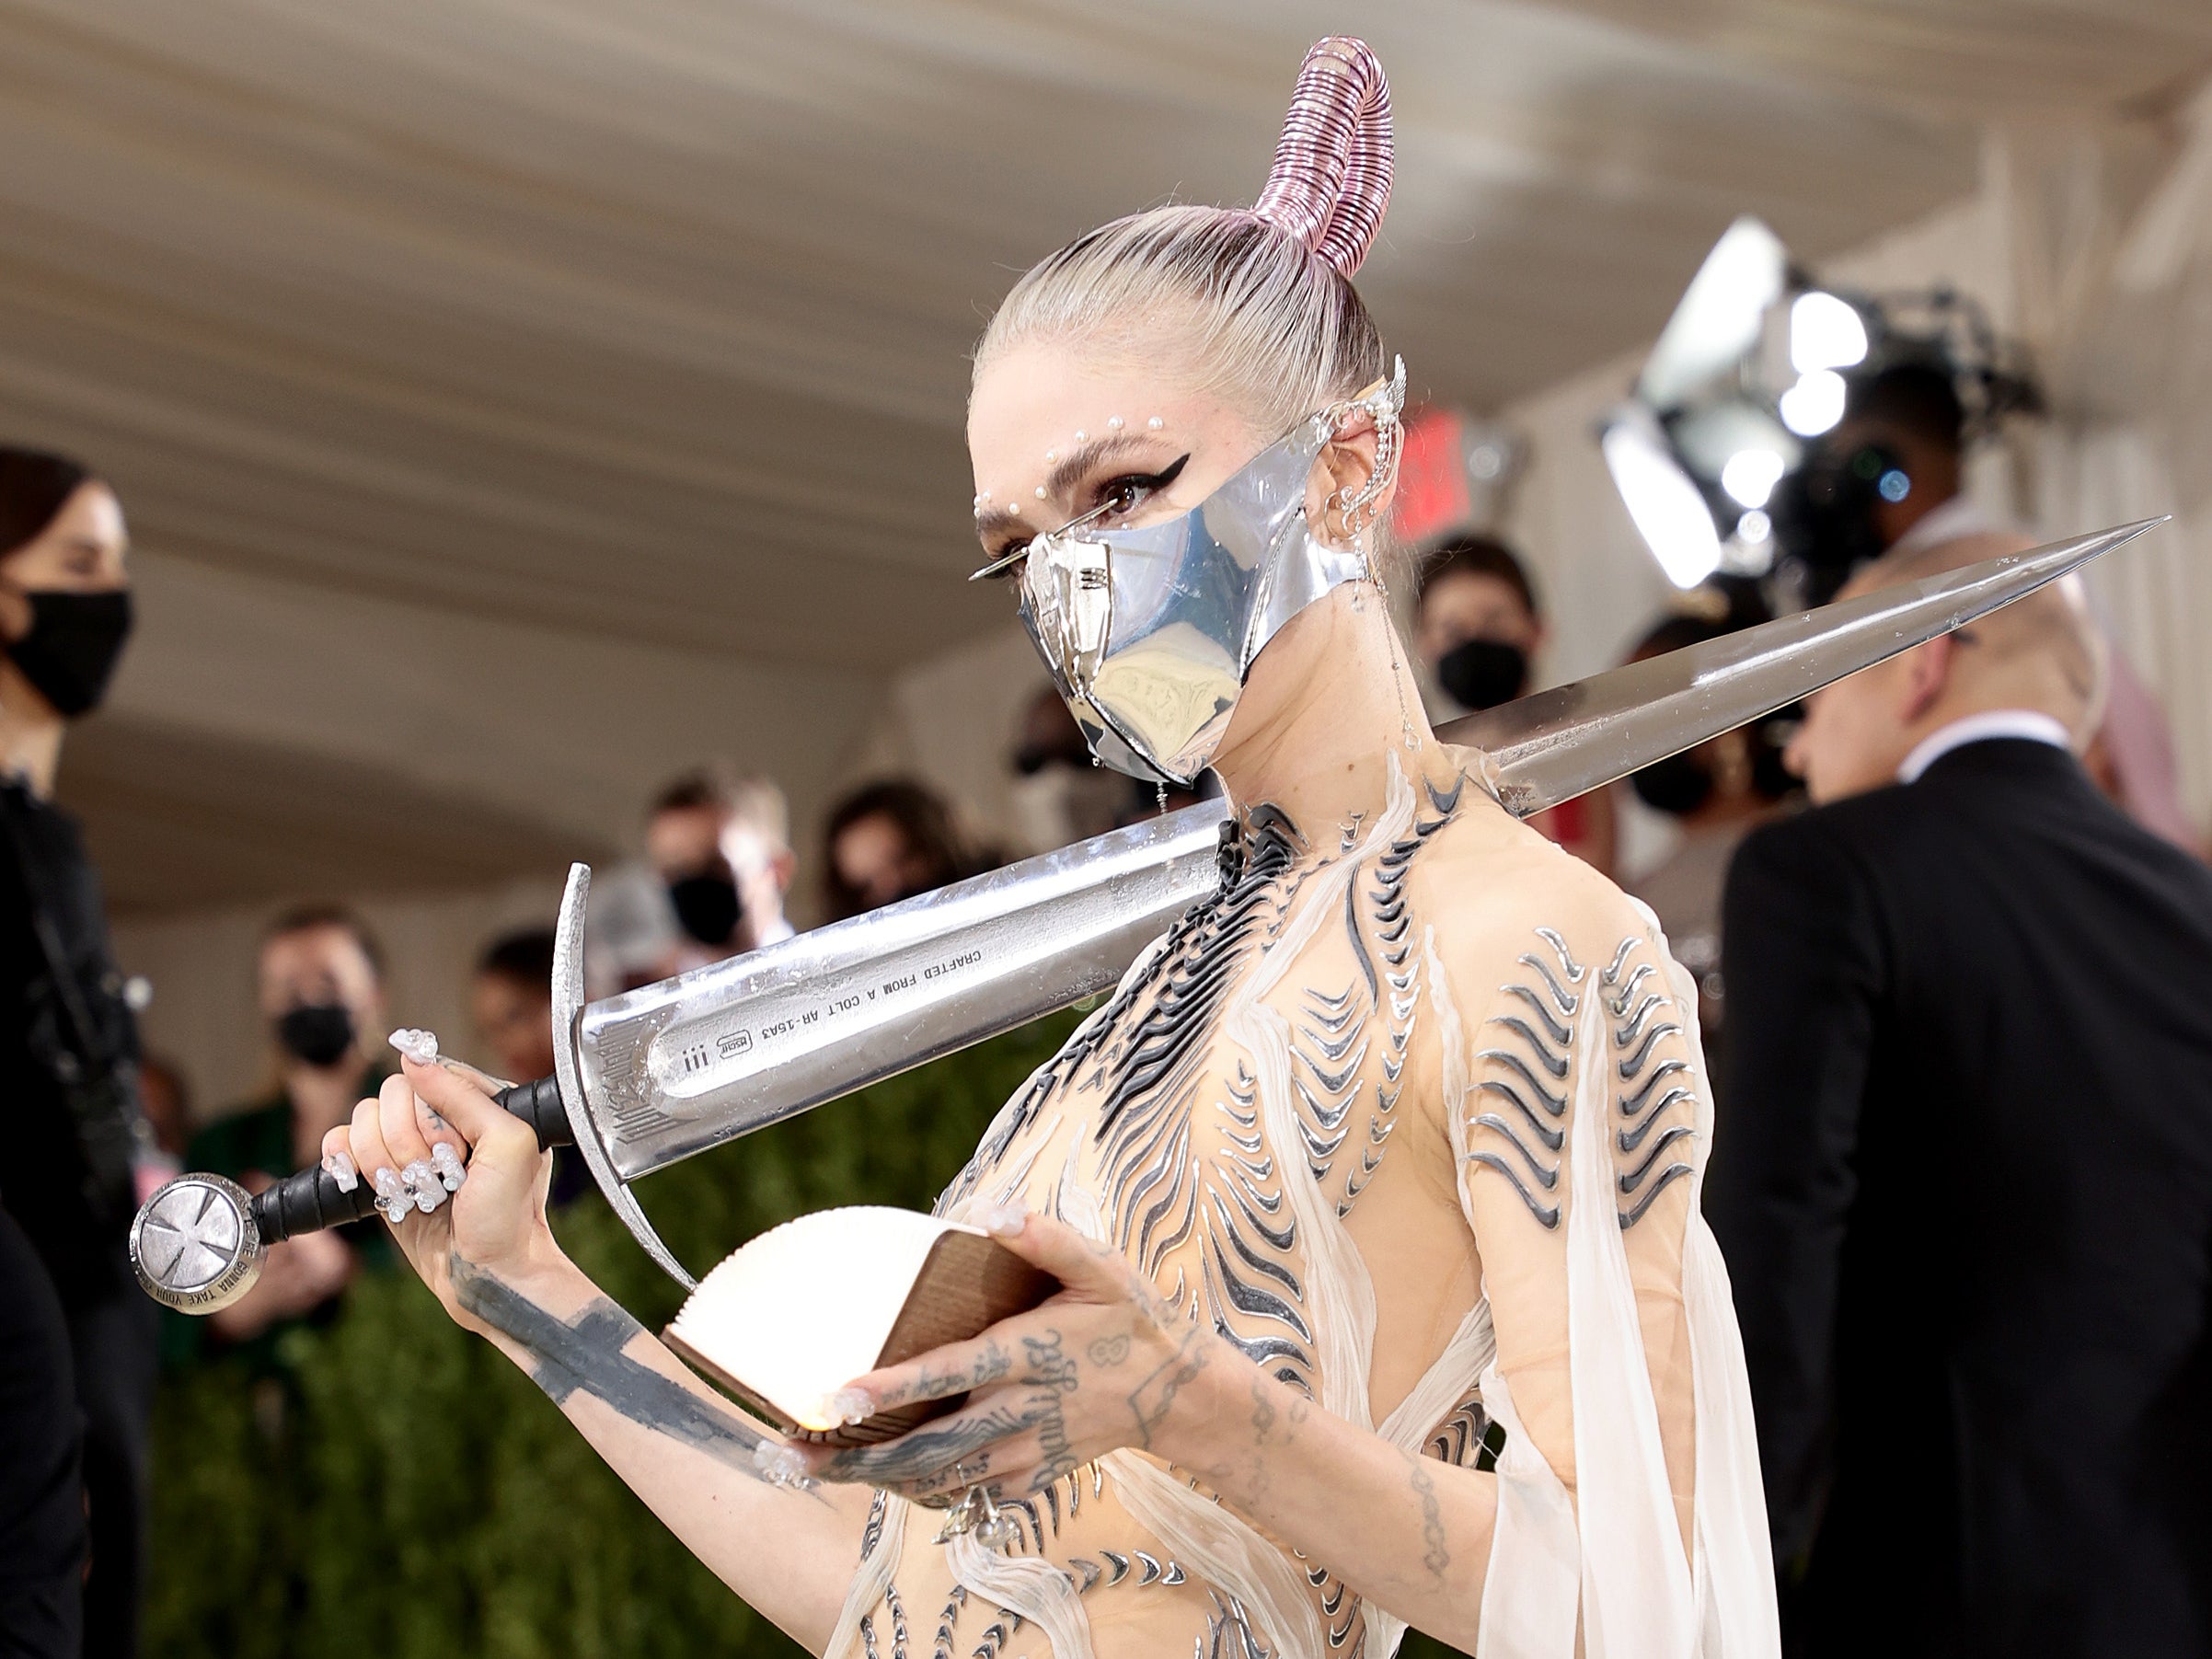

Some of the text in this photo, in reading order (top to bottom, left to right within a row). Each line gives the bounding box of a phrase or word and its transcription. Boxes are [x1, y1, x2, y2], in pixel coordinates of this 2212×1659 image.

[761, 950, 982, 1040] CRAFTED FROM A COLT AR-15A3
[216, 1261, 248, 1293] GONNA
[156, 1290, 182, 1306] YOUR
[188, 1294, 216, 1307] TAKE
